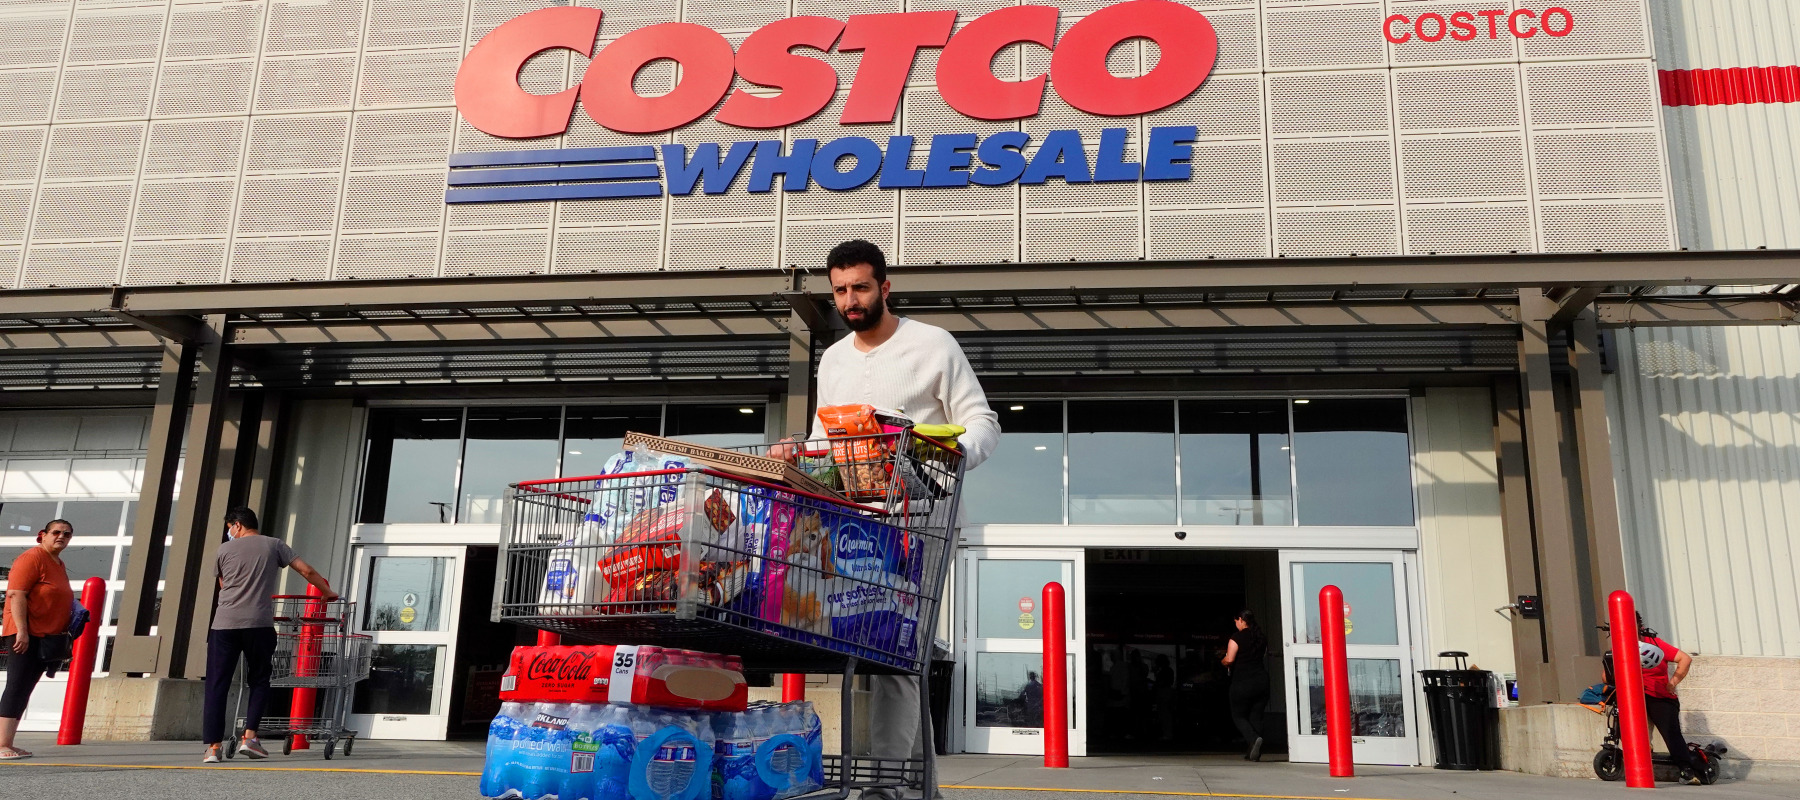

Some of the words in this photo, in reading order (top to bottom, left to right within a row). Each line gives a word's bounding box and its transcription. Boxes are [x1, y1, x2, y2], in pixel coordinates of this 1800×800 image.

[1383, 7, 1574, 44] COSTCO
[454, 0, 1219, 138] COSTCO
[661, 125, 1199, 195] WHOLESALE
[664, 443, 687, 453] FRESH
[690, 449, 715, 459] BAKED
[718, 454, 741, 464] PIZZA
[527, 650, 598, 681] Coca-Cola
[614, 653, 634, 668] 35
[577, 734, 593, 744] 40
